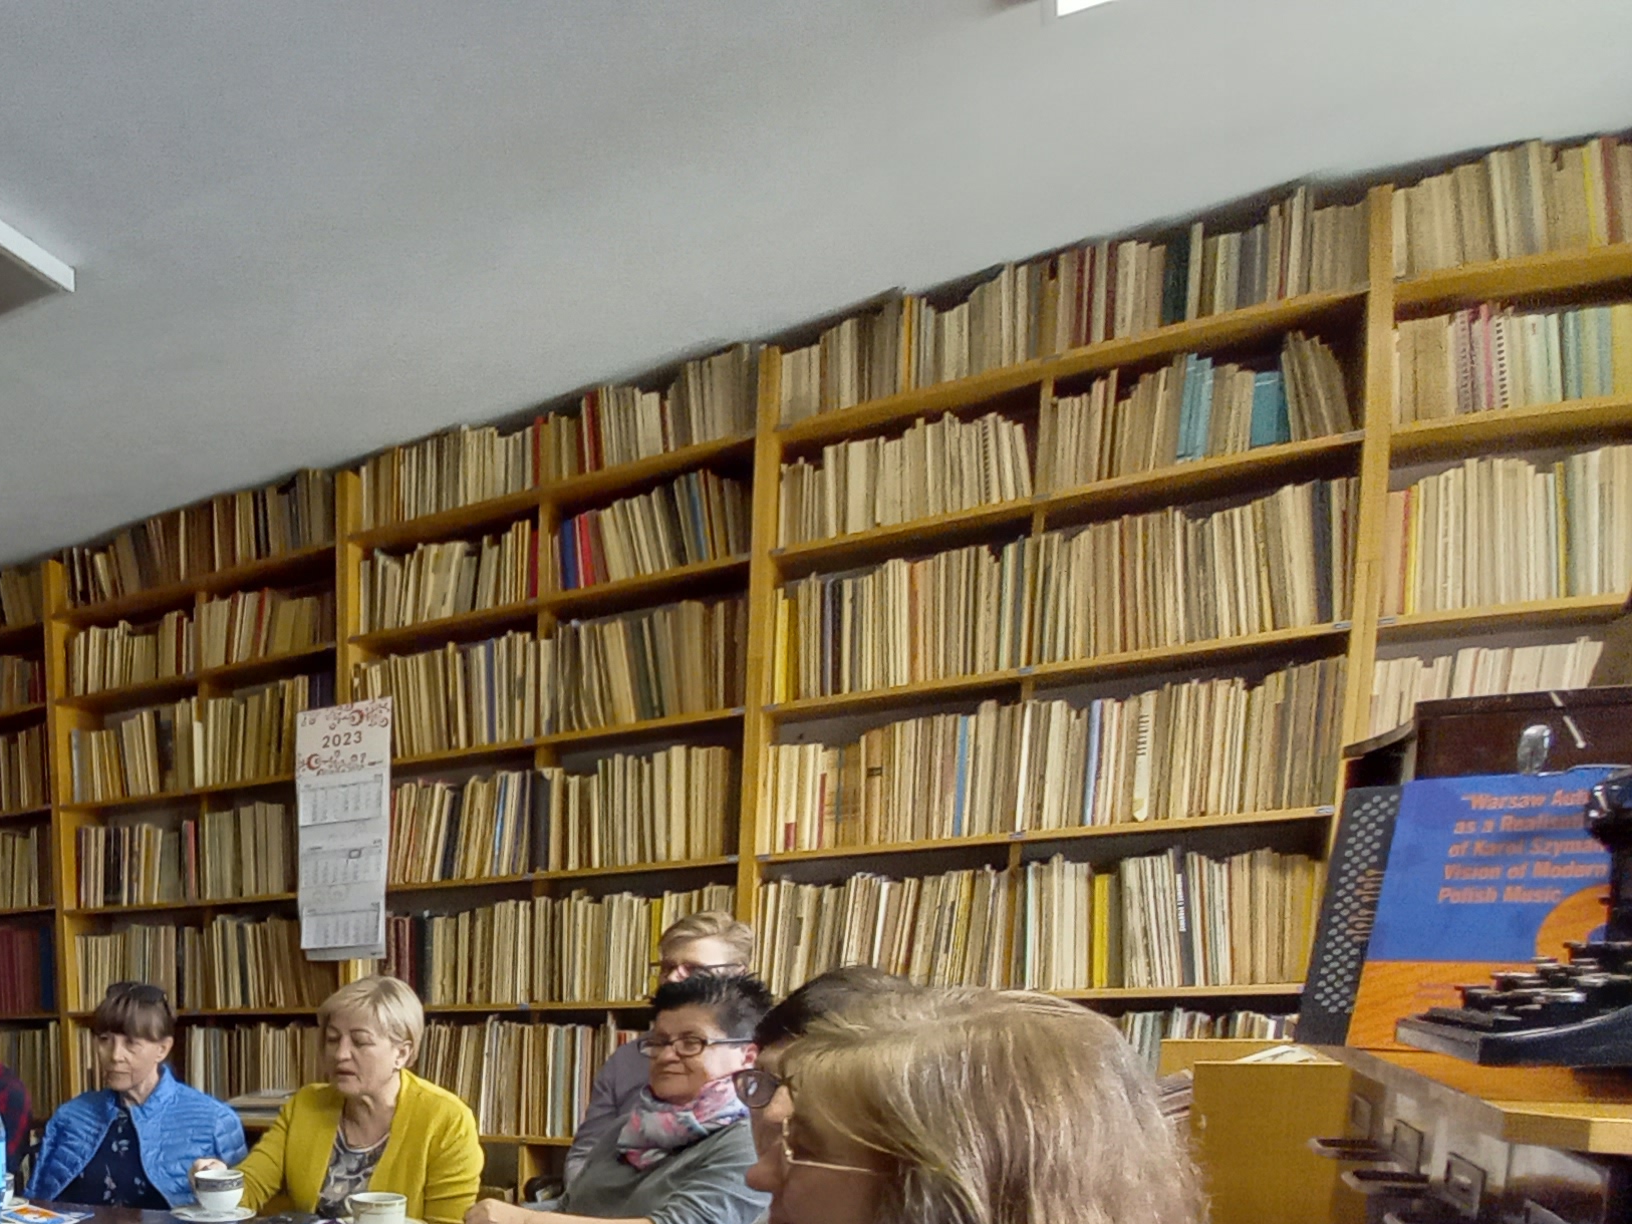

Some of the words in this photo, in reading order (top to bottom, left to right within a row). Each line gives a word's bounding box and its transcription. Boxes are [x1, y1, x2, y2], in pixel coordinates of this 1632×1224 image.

[322, 731, 362, 749] 2023
[1454, 820, 1476, 834] as
[1481, 820, 1494, 833] a
[1448, 840, 1470, 858] of
[1506, 861, 1528, 879] of
[1533, 860, 1608, 878] Modern
